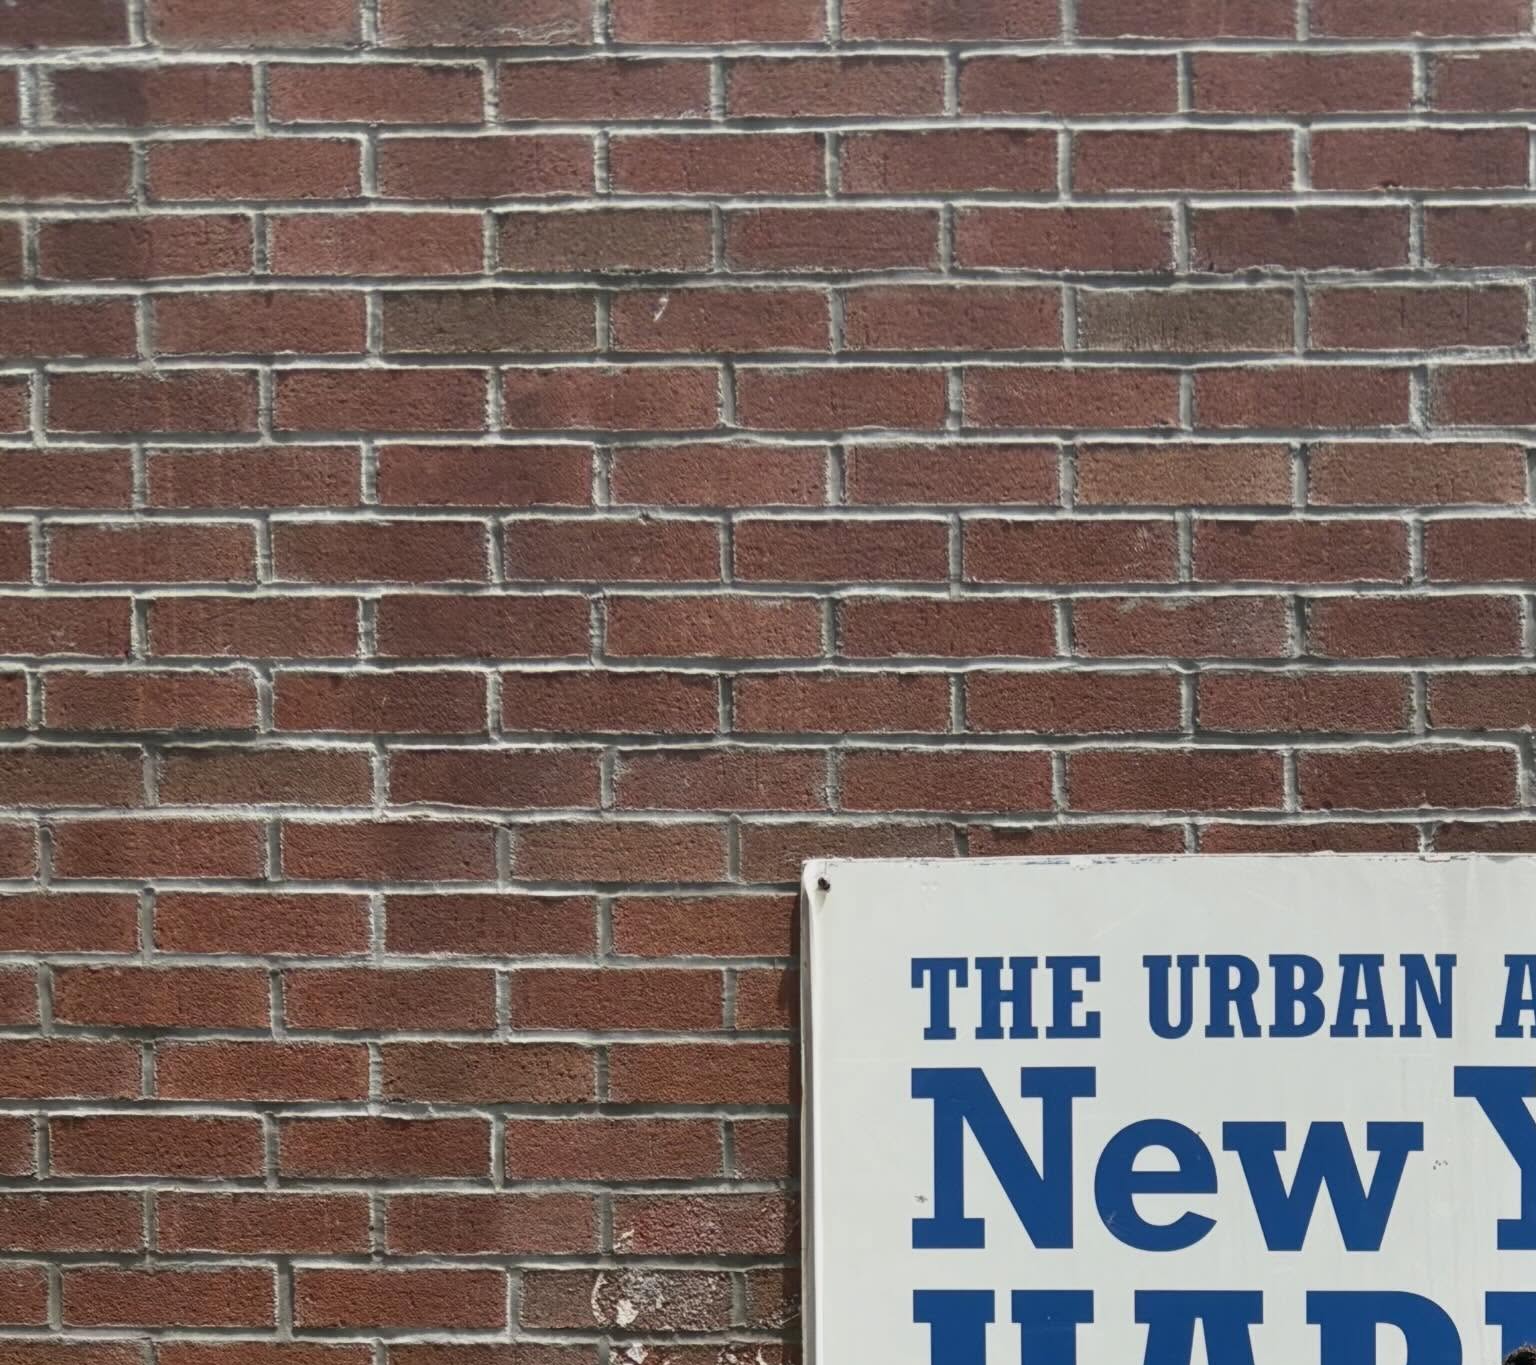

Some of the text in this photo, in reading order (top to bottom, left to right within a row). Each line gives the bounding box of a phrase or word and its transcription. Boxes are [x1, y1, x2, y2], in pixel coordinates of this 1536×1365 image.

[912, 956, 1100, 1040] THE
[1144, 954, 1456, 1039] URBAN
[912, 1067, 1424, 1252] New
